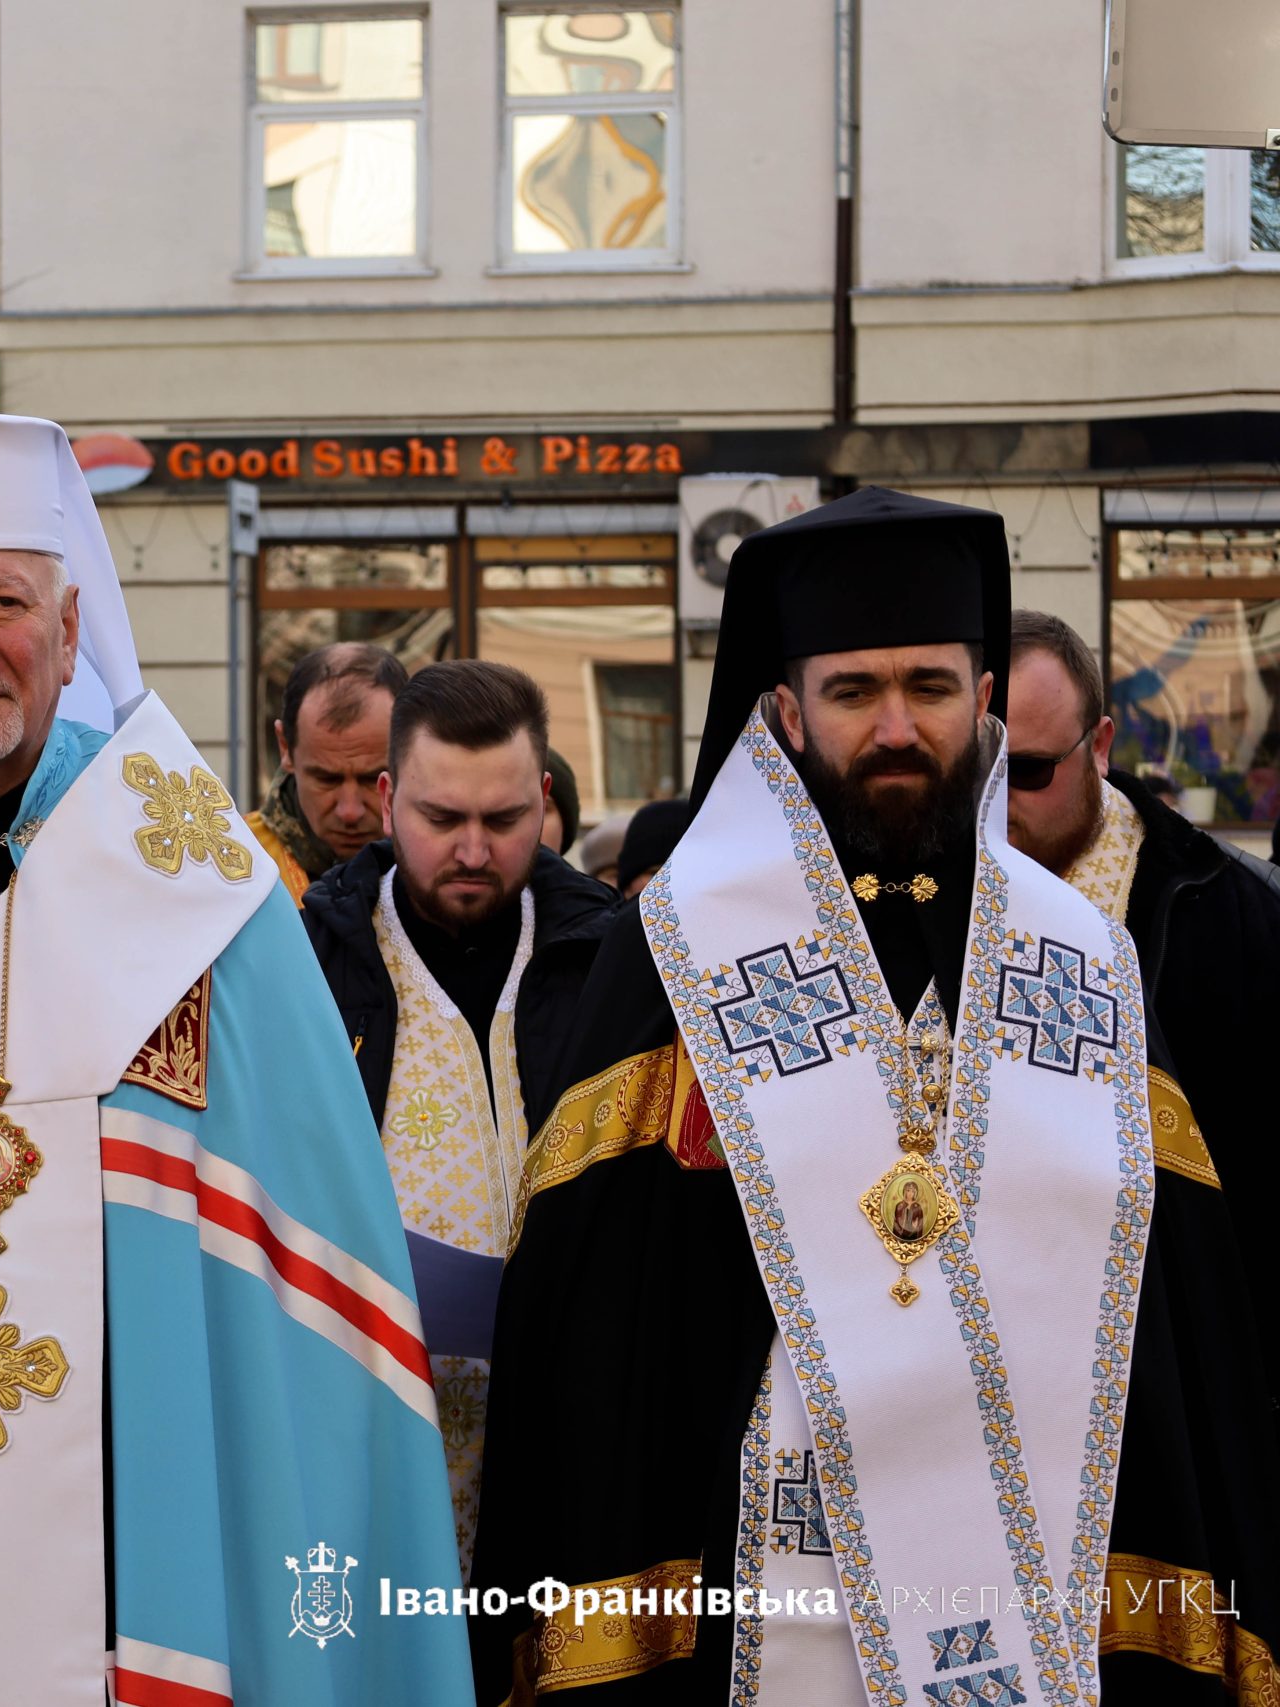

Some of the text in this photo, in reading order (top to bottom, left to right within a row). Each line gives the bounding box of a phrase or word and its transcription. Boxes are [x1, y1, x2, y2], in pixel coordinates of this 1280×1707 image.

[167, 435, 683, 479] Good Sushi & Pizza
